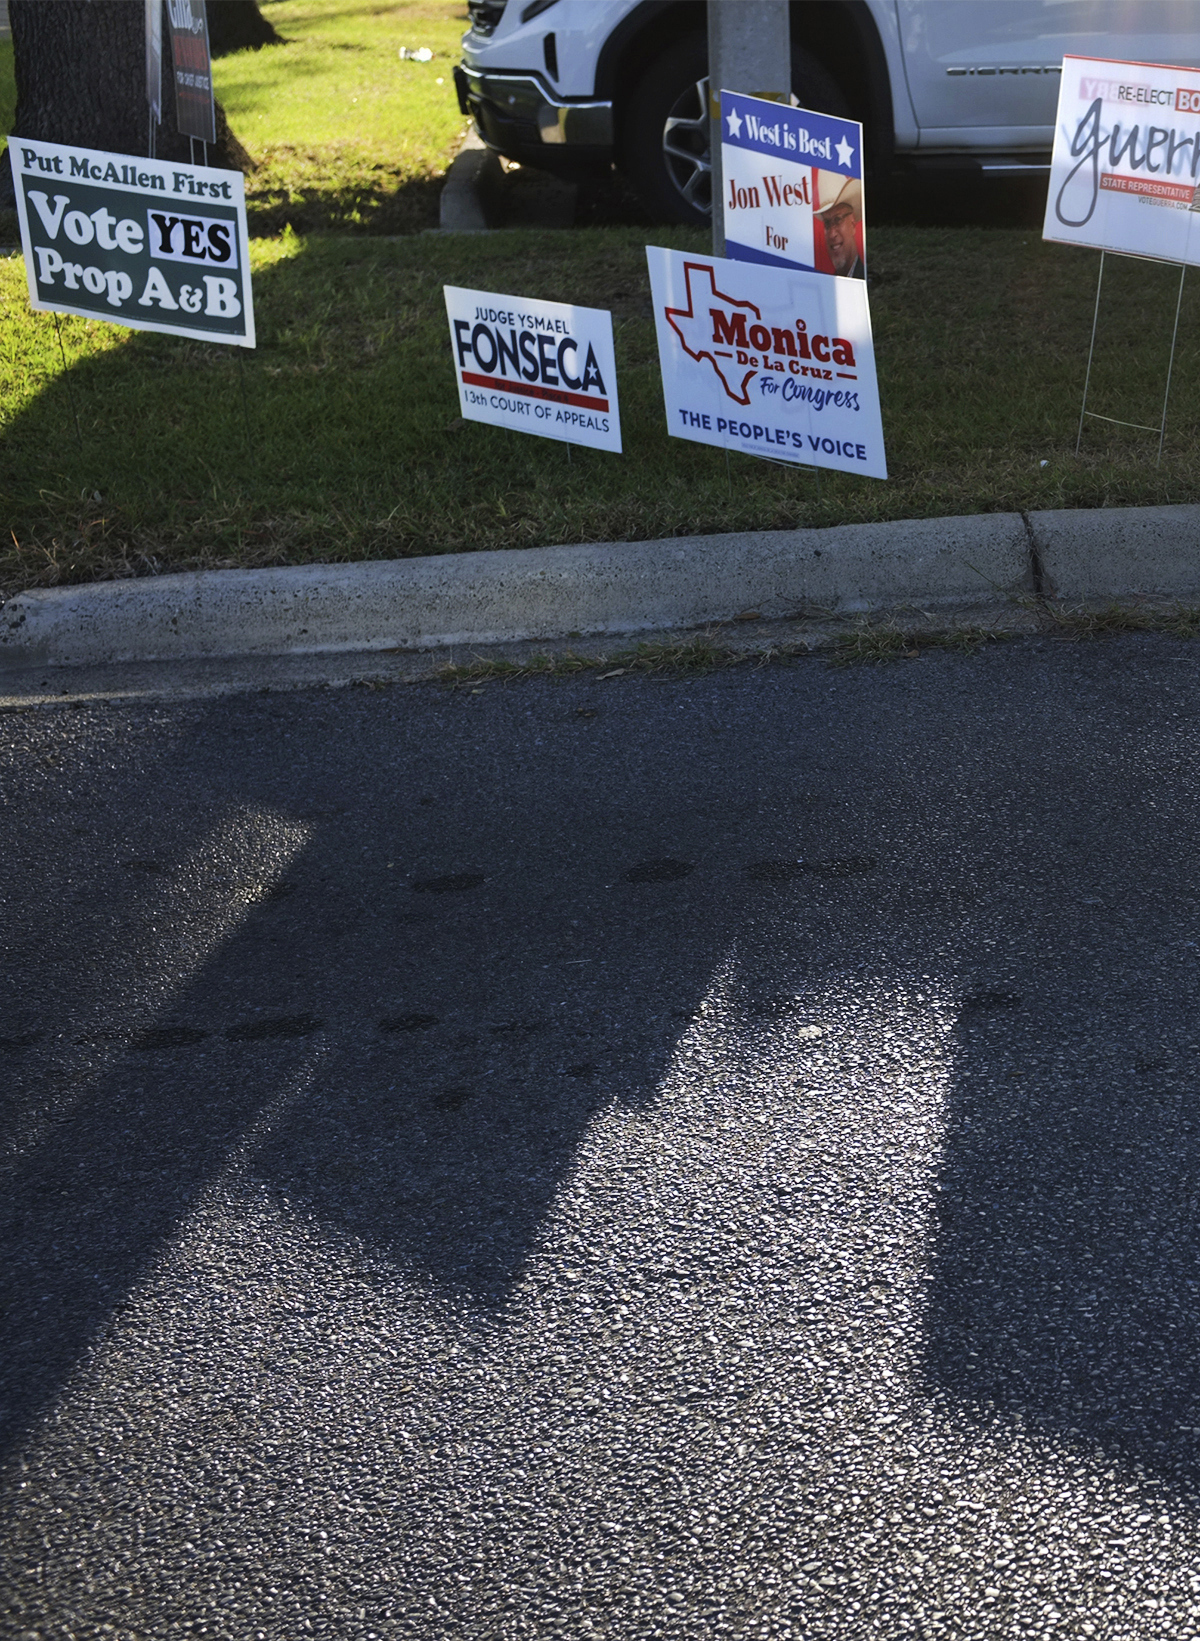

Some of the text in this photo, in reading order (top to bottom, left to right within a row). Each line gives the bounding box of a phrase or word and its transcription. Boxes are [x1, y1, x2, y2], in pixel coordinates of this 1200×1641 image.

[1118, 85, 1173, 106] RE-ELECT
[744, 114, 832, 160] West is Best
[21, 148, 232, 199] Put McAllen First
[728, 175, 812, 210] Jon West
[1102, 177, 1190, 200] STATE REPRESENTATIVE
[1138, 196, 1188, 211] VOTEGUERRA.COM
[27, 190, 231, 262] Vote YES
[765, 225, 789, 251] For
[34, 246, 133, 307] Prop
[475, 307, 569, 334] JUDGE YSMAEL
[709, 308, 856, 367] Monica
[453, 319, 607, 395] FONSECA
[736, 350, 832, 381] De La Cruz
[464, 390, 487, 406] 13th
[490, 396, 530, 415] COURT
[534, 406, 552, 419] OF
[556, 410, 609, 433] APPEALS
[760, 376, 860, 411] For Congress
[679, 409, 712, 430] THE
[716, 416, 803, 449] PEOPLE'S
[807, 435, 867, 461] VOICE
